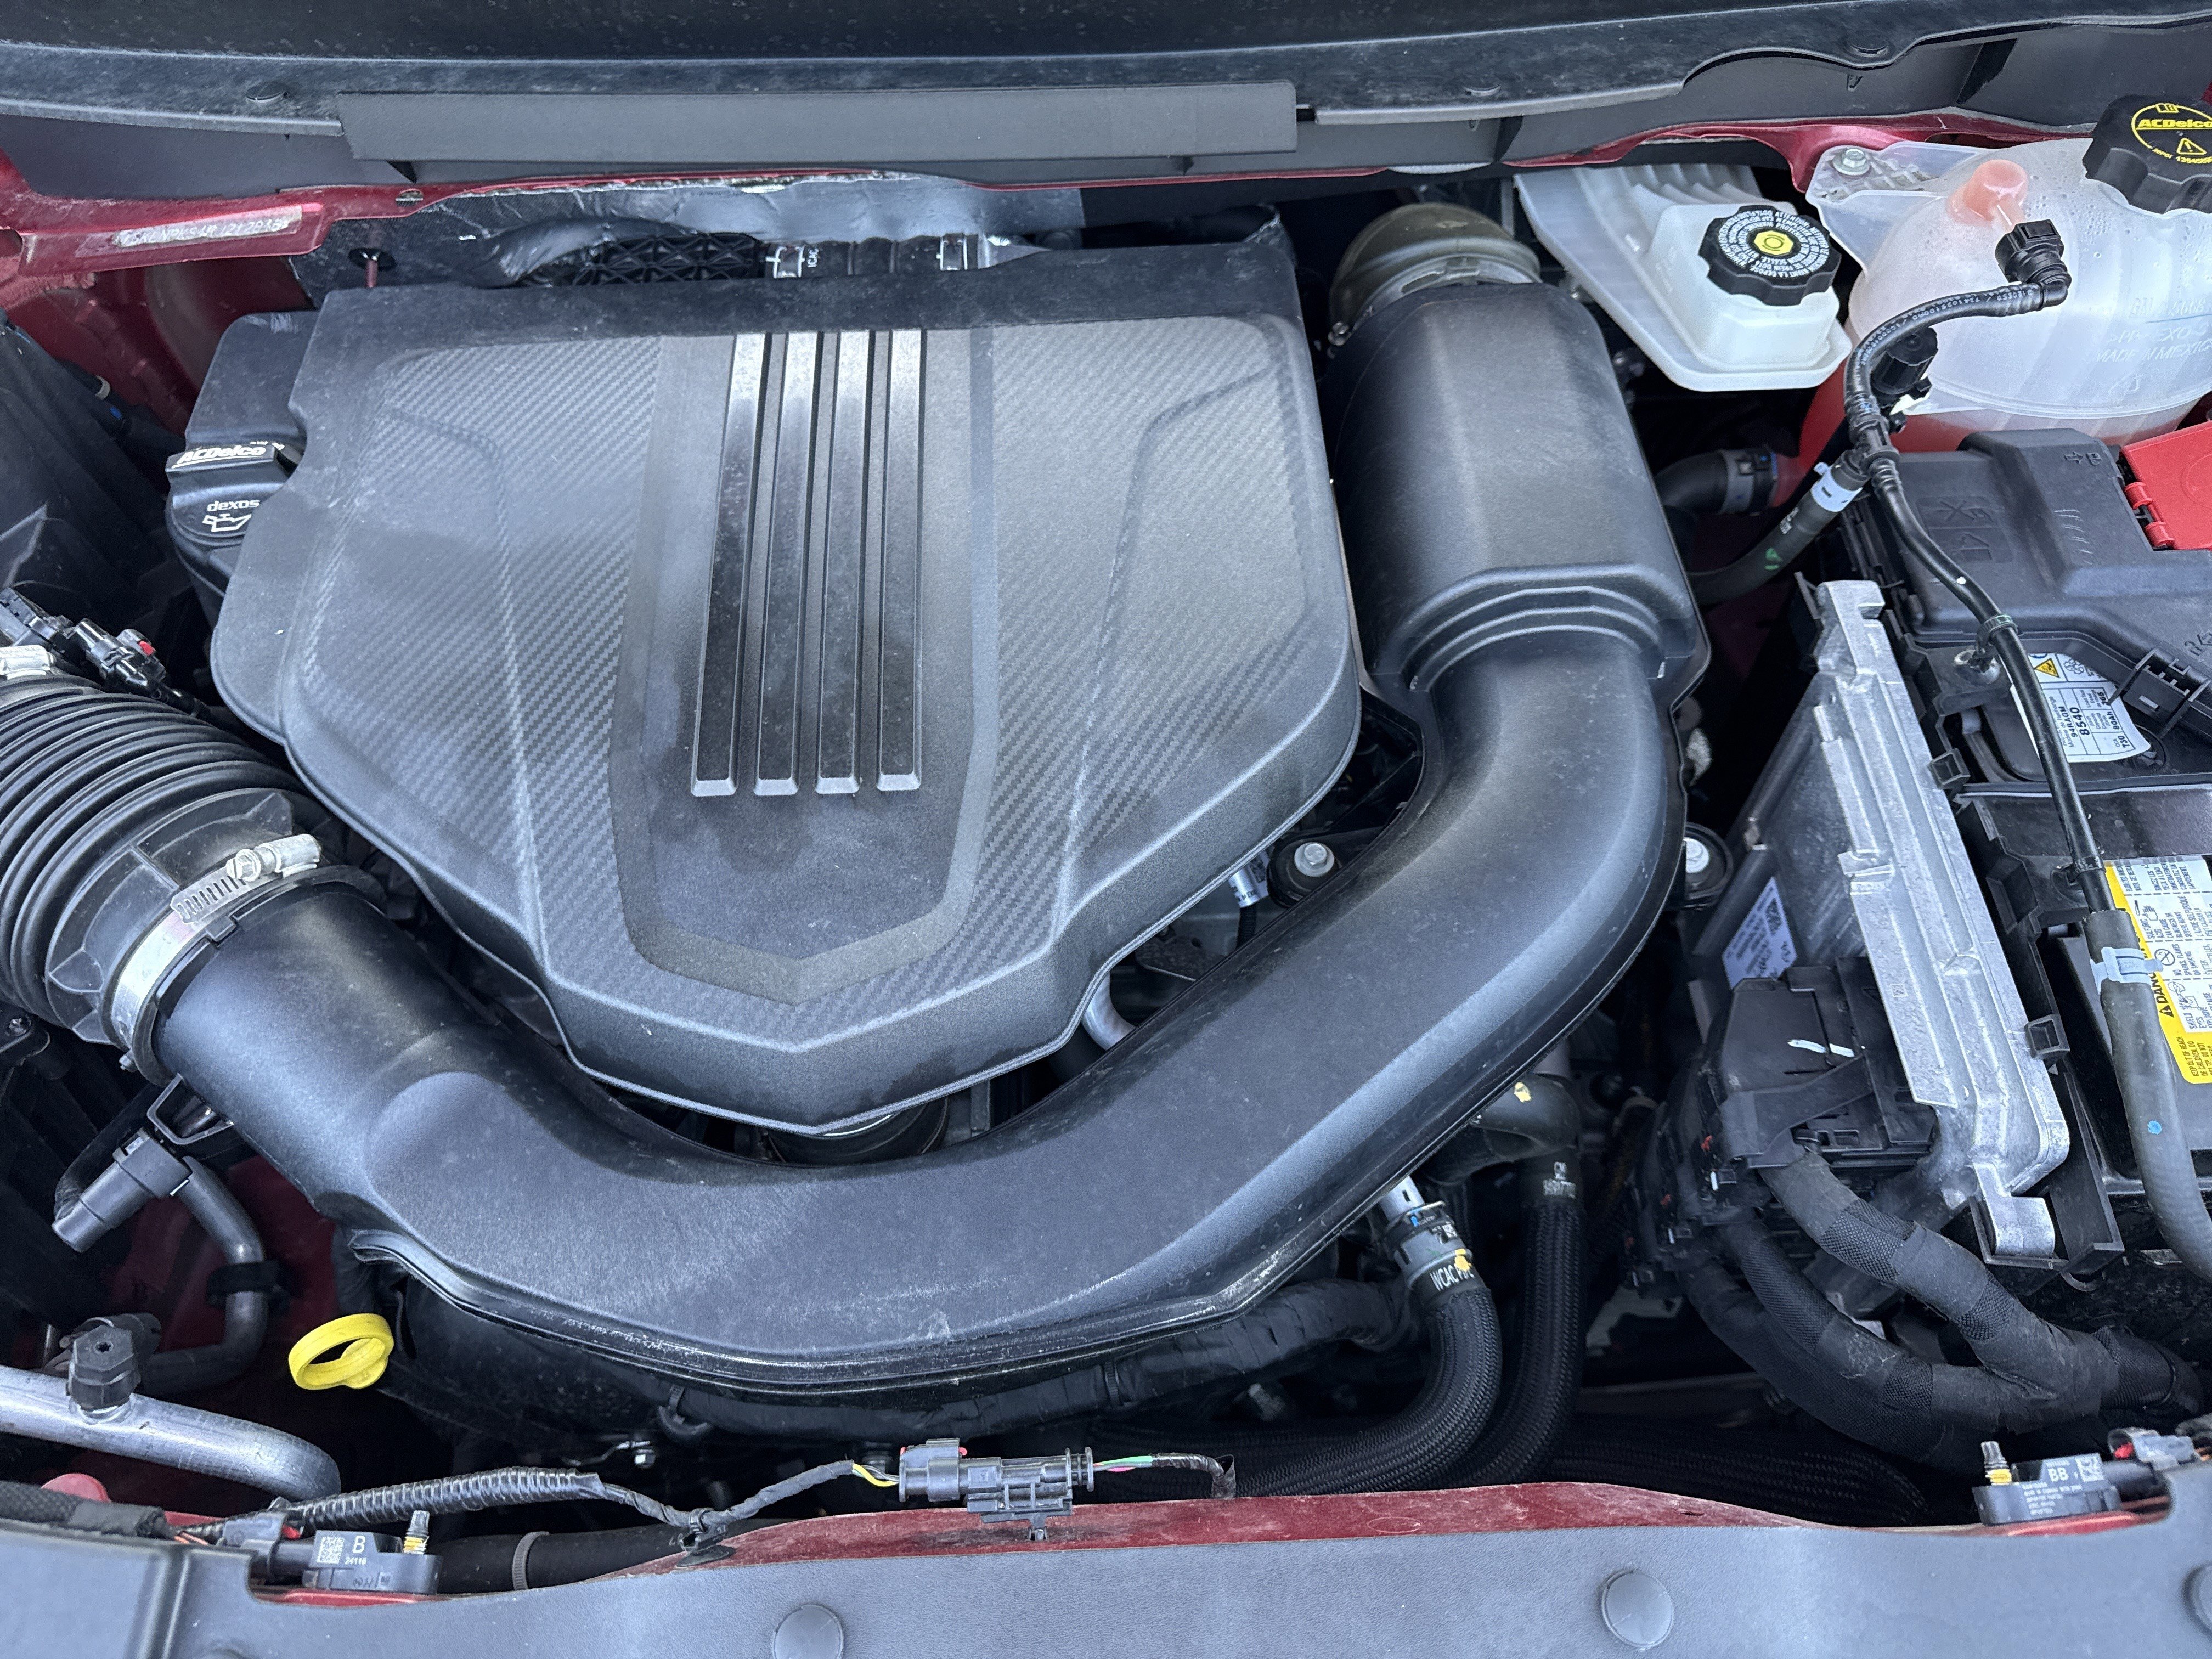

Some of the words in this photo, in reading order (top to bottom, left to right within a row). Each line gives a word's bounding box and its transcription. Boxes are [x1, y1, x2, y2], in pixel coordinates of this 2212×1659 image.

[2137, 119, 2212, 127] ACDelco
[2156, 338, 2212, 360] MEXIC
[177, 445, 266, 464] ACDelco
[207, 500, 261, 511] dexos
[2058, 706, 2078, 737] 94RAGM
[2069, 707, 2090, 736] 8540
[2107, 712, 2120, 730] 80Ah
[2118, 735, 2130, 748] 730
[2154, 928, 2165, 938] ACID
[2171, 944, 2184, 959] FLAMES
[2183, 1012, 2197, 1029] SHIELD
[2196, 1017, 2207, 1029] EYES
[2176, 1036, 2188, 1050] REACH
[2185, 1057, 2194, 1065] OUT
[2189, 1066, 2199, 1076] KEEP
[1430, 1265, 1459, 1291] WCAC
[2048, 1467, 2069, 1482] BB
[352, 1536, 366, 1554] B
